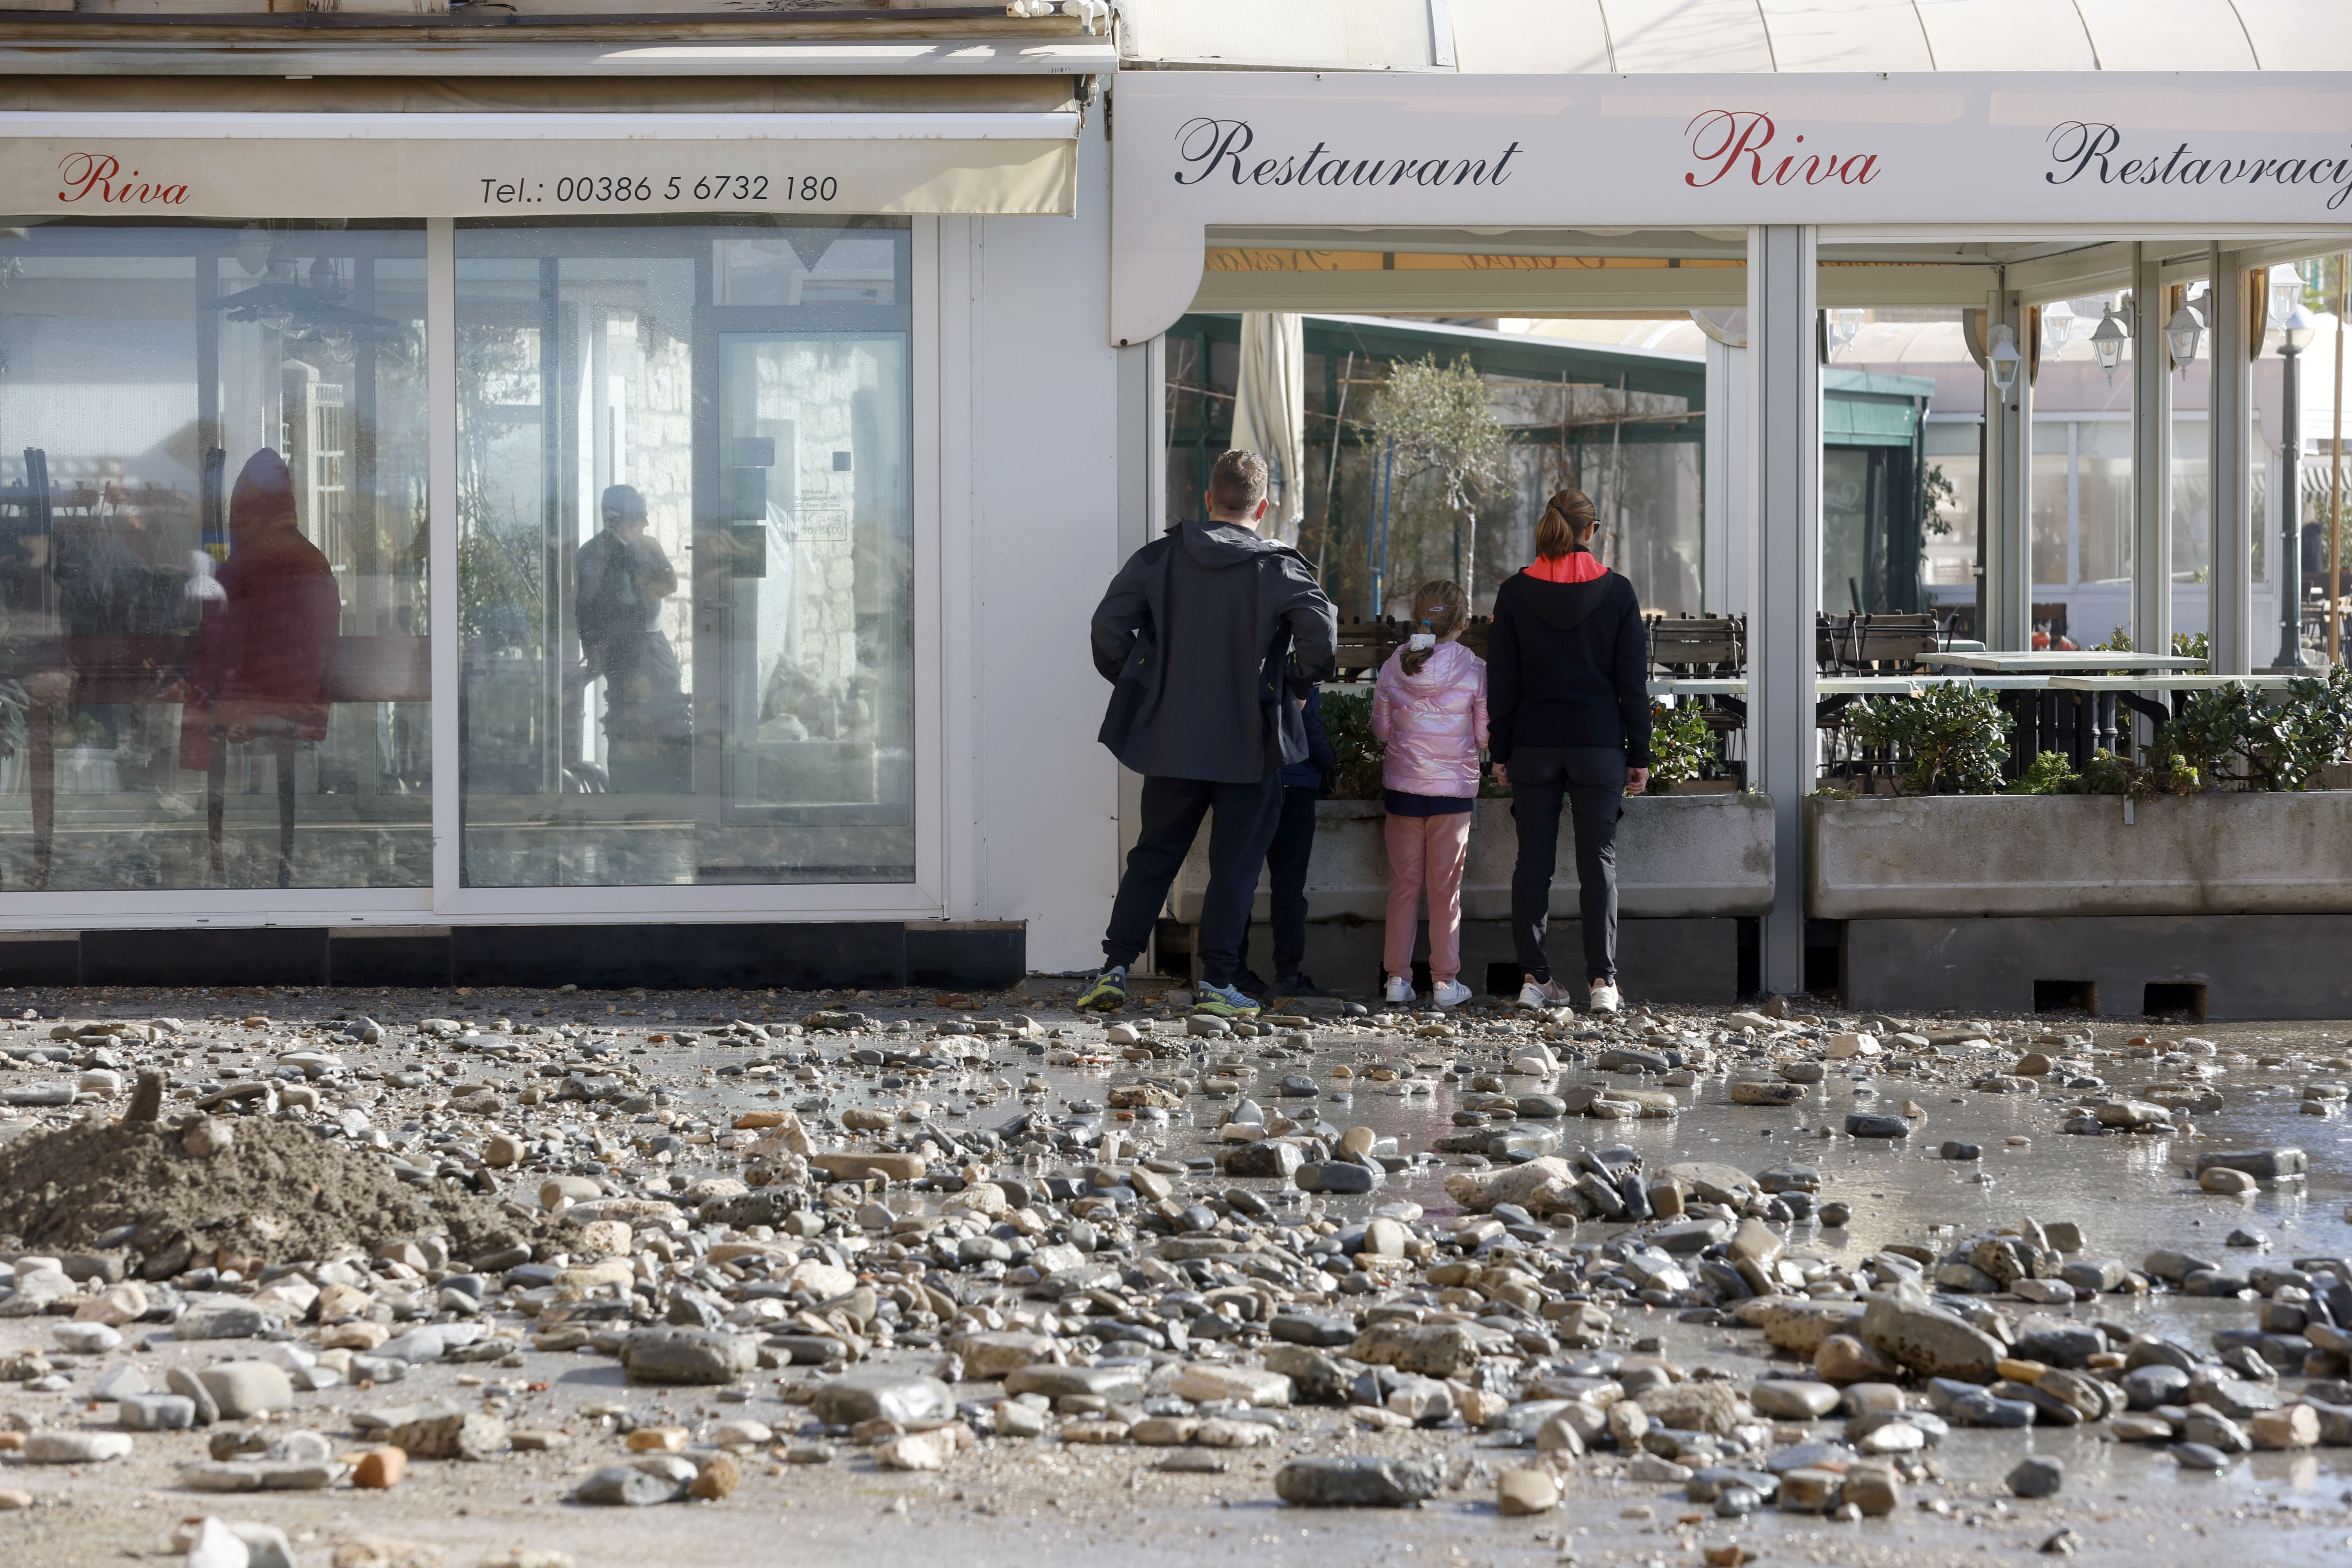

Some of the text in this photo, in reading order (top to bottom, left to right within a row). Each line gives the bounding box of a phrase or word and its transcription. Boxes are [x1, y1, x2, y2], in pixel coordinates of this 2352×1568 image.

[1174, 117, 1523, 186] Restaurant
[1684, 109, 1881, 187] Riva
[58, 152, 191, 204] Riva
[481, 176, 837, 203] Tel.: 00386 5 6732 180
[1207, 991, 1226, 1004] HOKA
